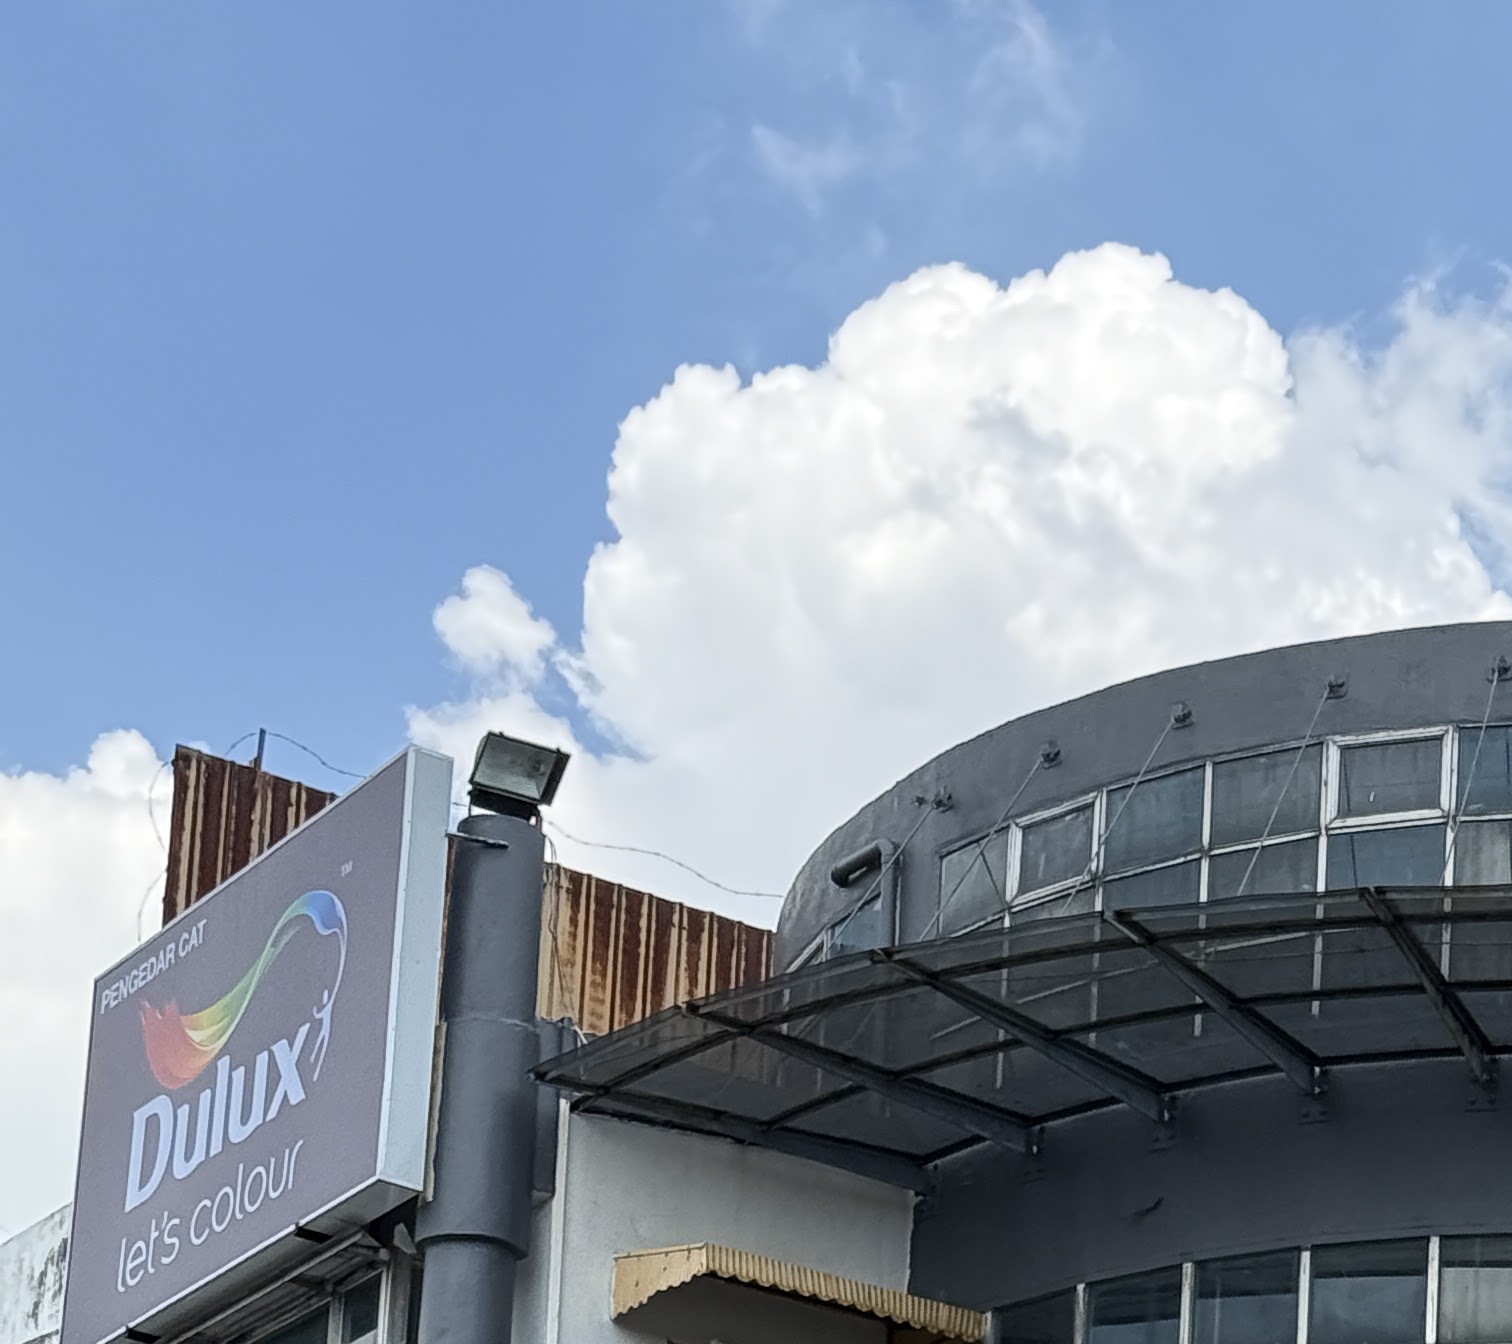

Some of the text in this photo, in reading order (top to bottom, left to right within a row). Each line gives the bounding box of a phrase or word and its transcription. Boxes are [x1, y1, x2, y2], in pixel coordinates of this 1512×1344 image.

[100, 919, 208, 1014] PENGEDAR CAT
[125, 1023, 310, 1213] Dulux
[117, 1140, 303, 1292] let's colour
